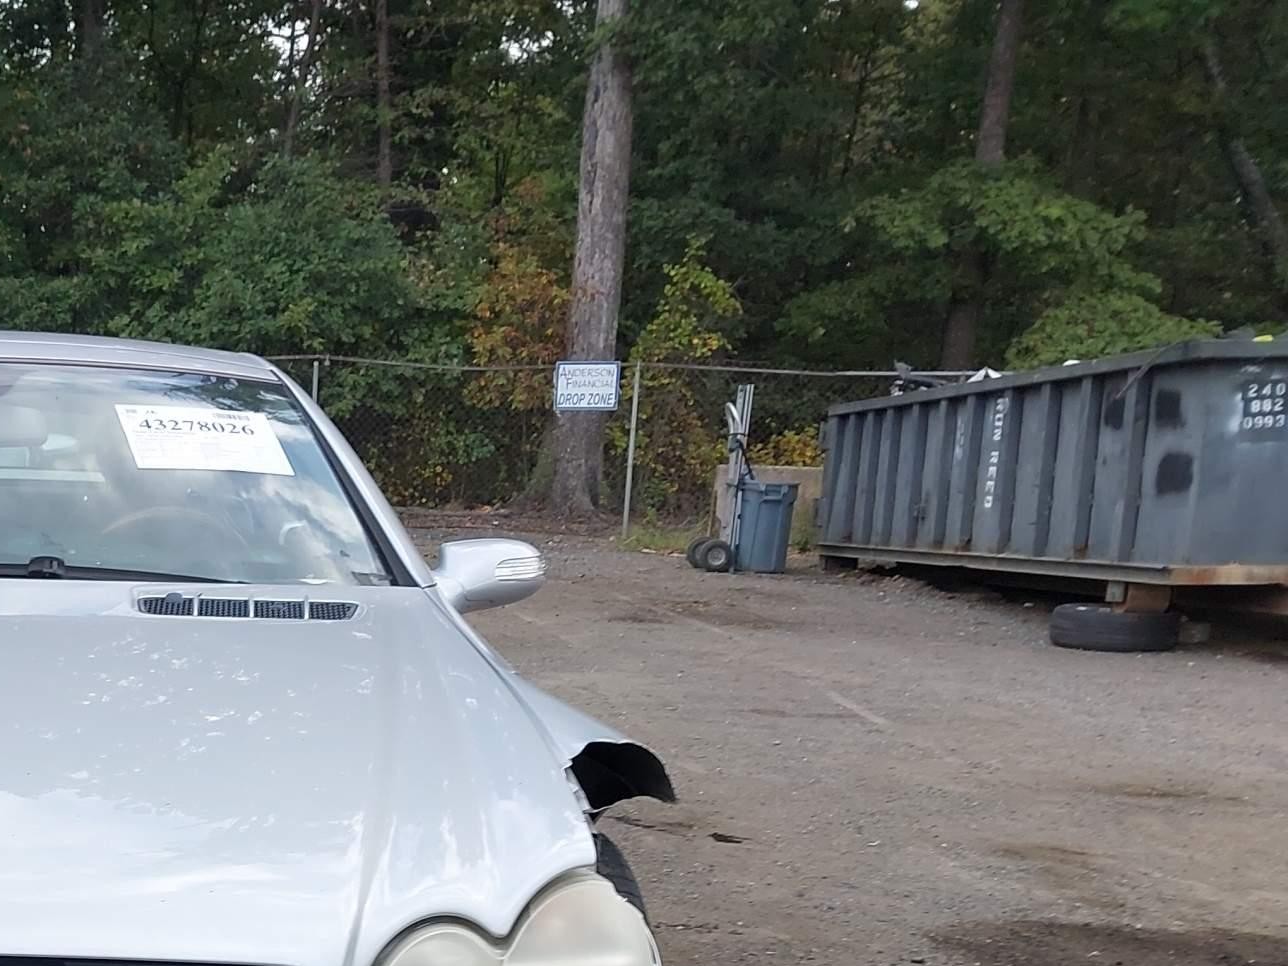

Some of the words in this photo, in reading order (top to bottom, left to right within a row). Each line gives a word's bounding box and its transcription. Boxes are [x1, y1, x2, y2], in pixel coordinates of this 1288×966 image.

[560, 366, 615, 377] ANDERSON
[566, 377, 615, 389] FINANCIAL
[1247, 383, 1286, 398] 240
[558, 393, 586, 406] DROP
[587, 393, 614, 406] ZONE
[139, 418, 255, 436] 43278026
[984, 451, 1000, 508] REED
